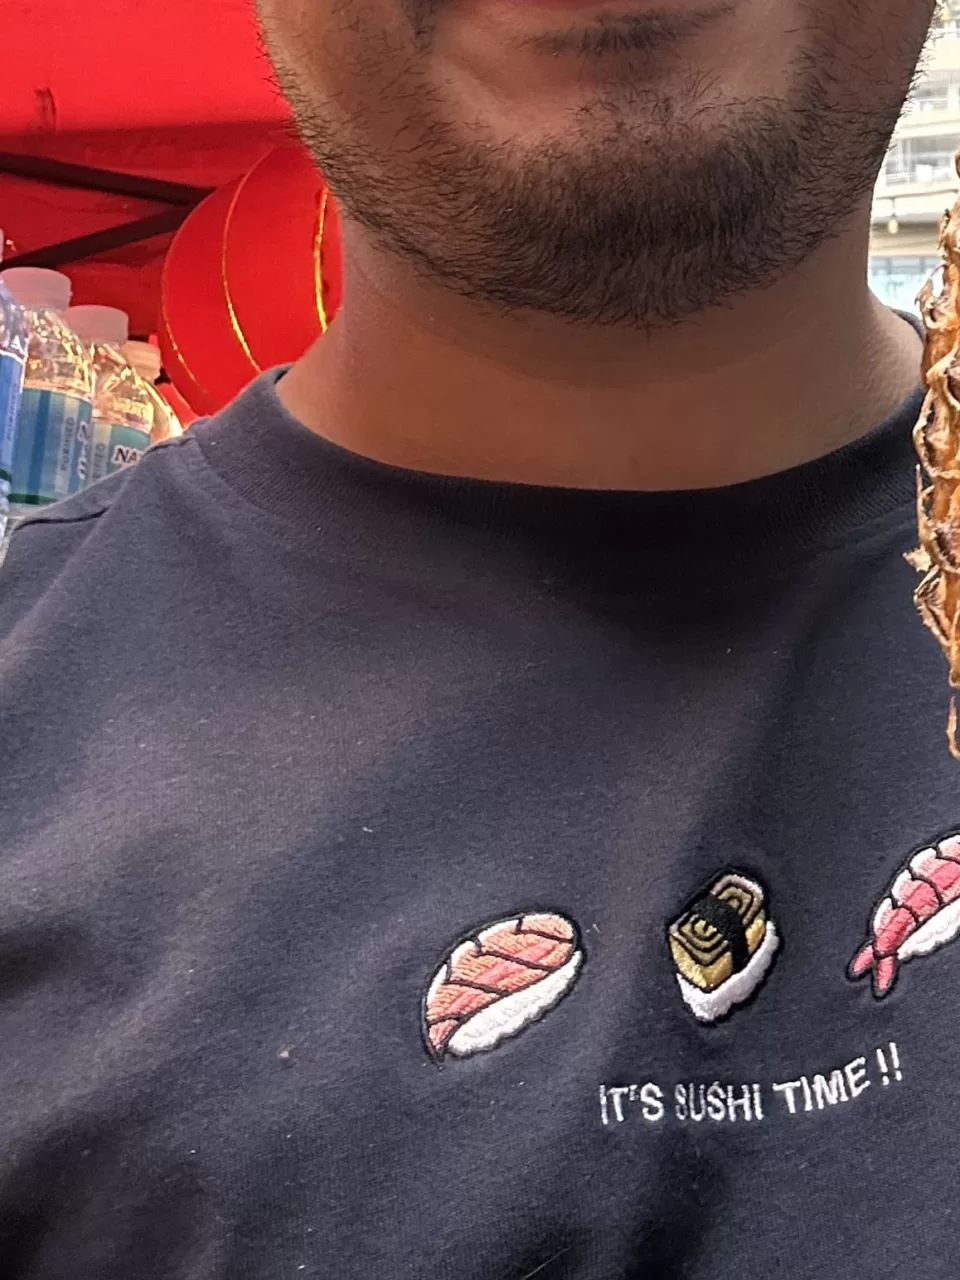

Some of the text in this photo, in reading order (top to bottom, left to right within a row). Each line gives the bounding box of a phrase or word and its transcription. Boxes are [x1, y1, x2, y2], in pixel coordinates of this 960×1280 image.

[113, 446, 140, 464] NA
[599, 1082, 665, 1125] IT'S
[673, 1080, 764, 1122] SUSHI
[772, 1056, 871, 1114] TIME
